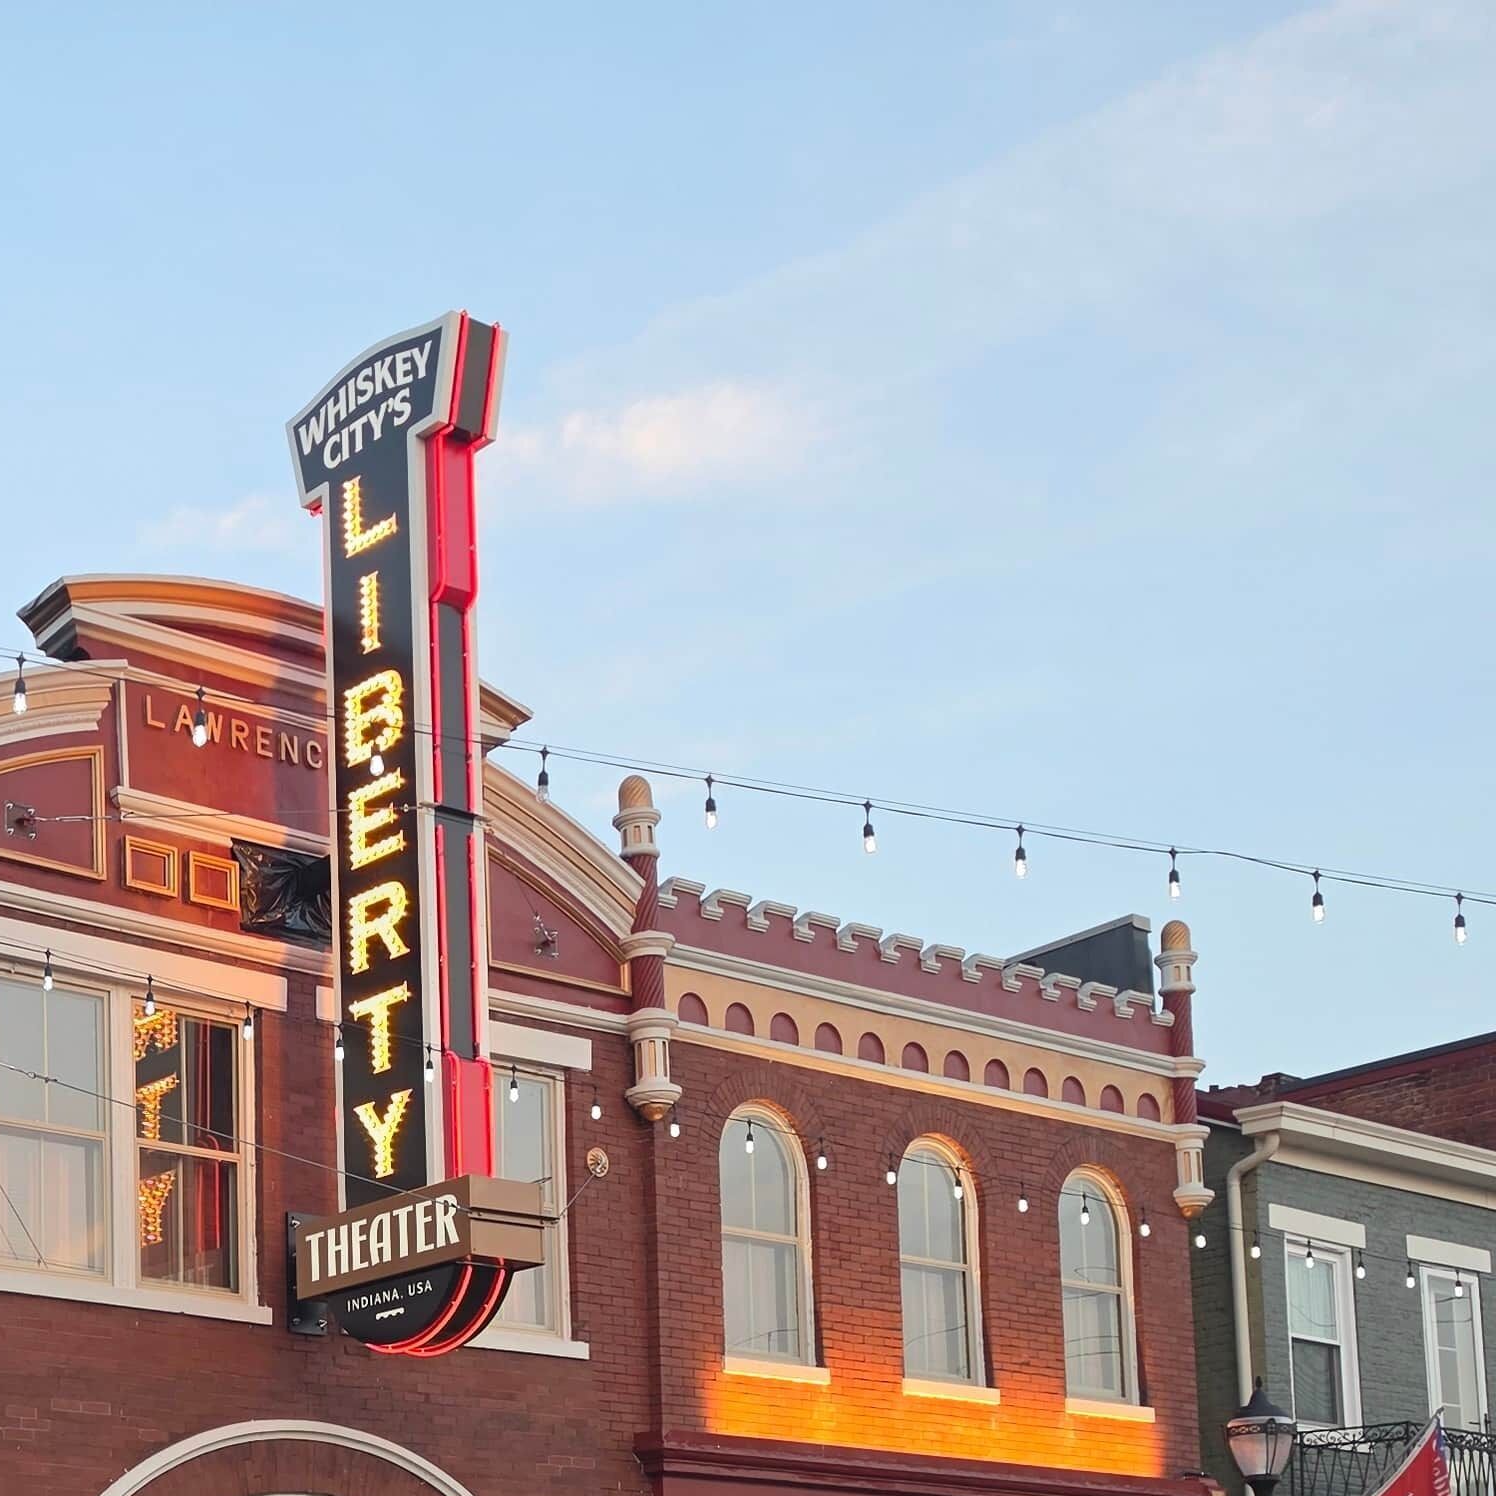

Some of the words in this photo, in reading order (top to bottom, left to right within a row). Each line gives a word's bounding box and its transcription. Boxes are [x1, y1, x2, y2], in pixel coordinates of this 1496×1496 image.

[298, 340, 432, 456] WHISKEY
[322, 387, 412, 469] CITY'S
[343, 475, 415, 1179] LIBERTY
[305, 1194, 460, 1282] THEATER
[408, 1280, 432, 1296] USA
